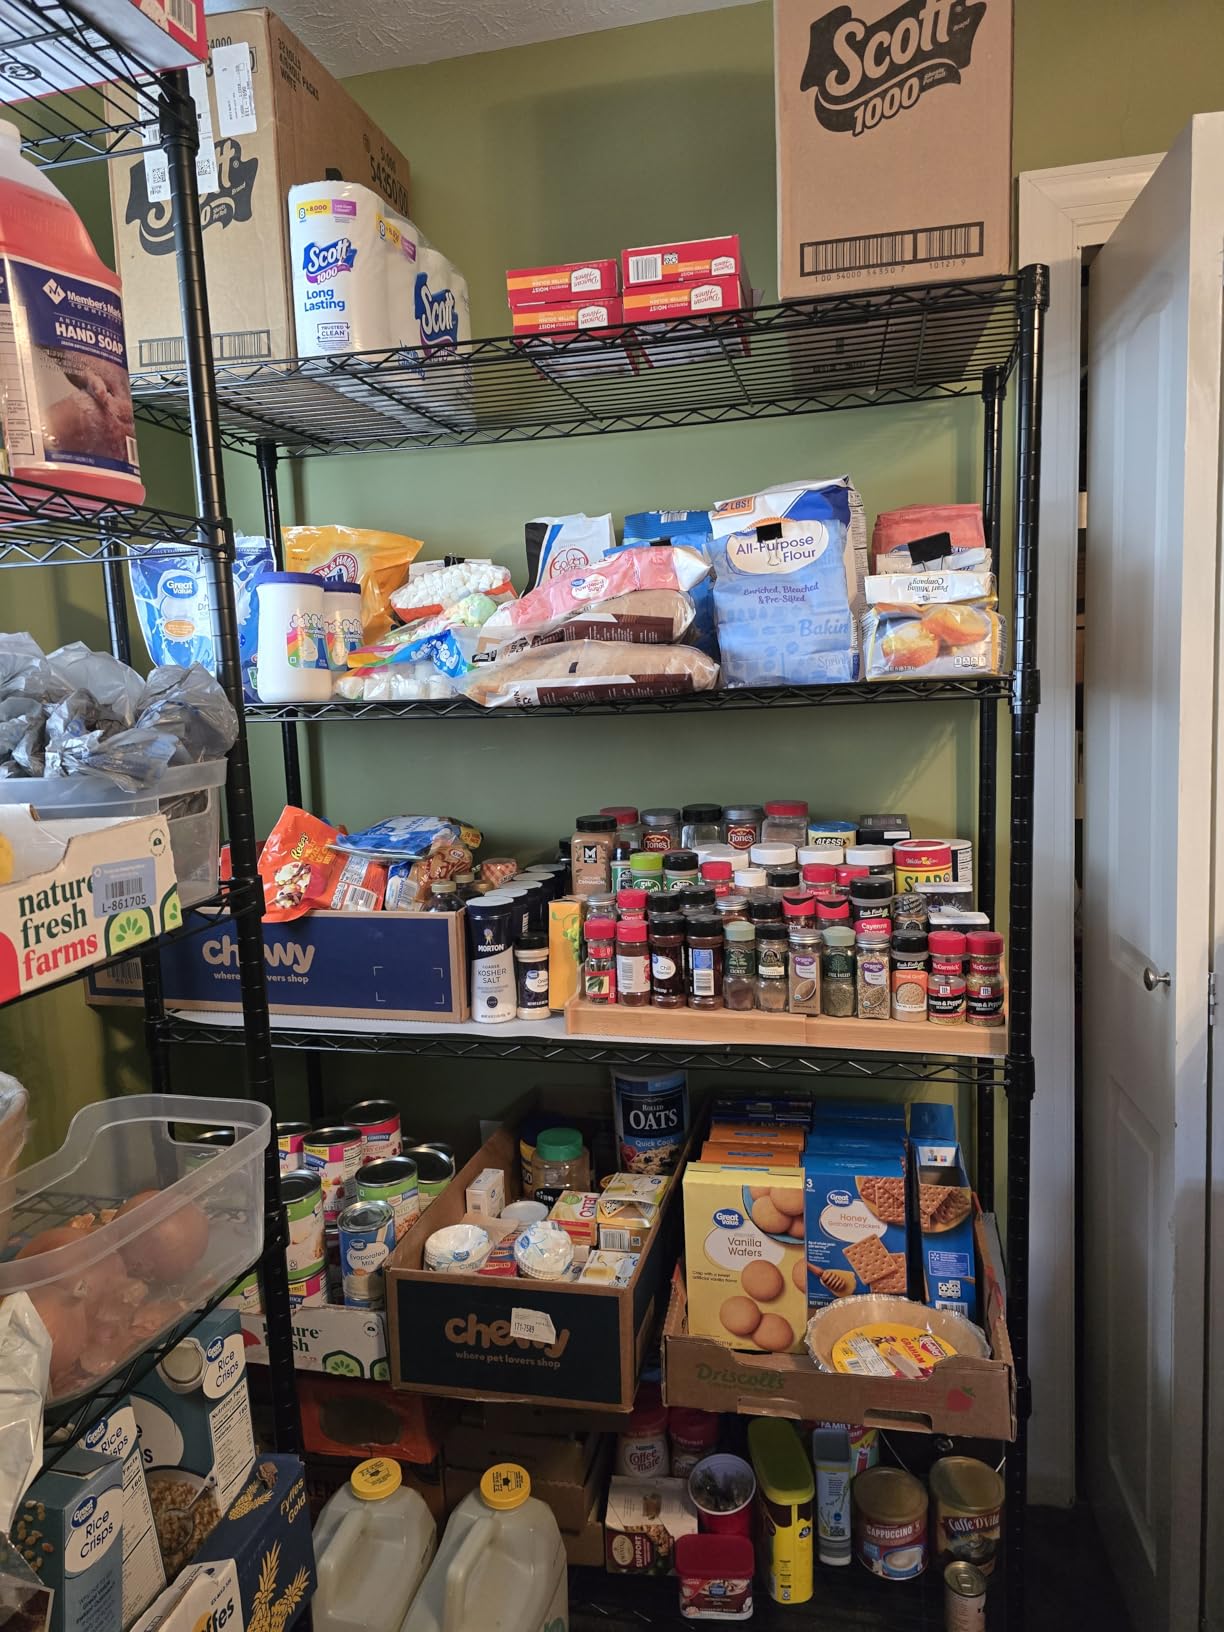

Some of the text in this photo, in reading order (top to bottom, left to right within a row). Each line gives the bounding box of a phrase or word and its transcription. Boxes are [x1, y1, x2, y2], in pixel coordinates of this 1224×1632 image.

[826, 0, 951, 97] Scott
[853, 76, 920, 138] 1000
[307, 238, 350, 273] Scott
[316, 266, 338, 285] 1000
[306, 288, 335, 301] Long
[532, 286, 549, 294] MOIST
[67, 290, 122, 320] Member's Mark
[304, 299, 346, 313] Lasting
[421, 284, 455, 335] Scott
[55, 322, 96, 345] HAND
[97, 335, 124, 356] SOAP
[730, 500, 751, 510] LBS!
[736, 535, 814, 556] All-Purpose
[783, 549, 817, 563] Flour
[166, 580, 193, 589] Great
[782, 581, 820, 594] Bleached
[645, 839, 668, 848] Tone's
[731, 833, 754, 842] Tone's
[101, 894, 147, 913] L-861705
[20, 902, 88, 950] fresh
[477, 943, 506, 952] MORTON
[22, 933, 98, 982] farms
[477, 968, 507, 977] KOSHER
[932, 963, 960, 971] McCormick
[287, 975, 310, 985] shop
[482, 976, 501, 984] SALT
[629, 1108, 679, 1130] OATS
[806, 1178, 813, 1188] 3
[829, 1193, 849, 1201] Great
[715, 1212, 739, 1222] Great
[840, 1213, 868, 1222] Honey
[853, 1222, 880, 1230] Crackers
[727, 1236, 762, 1248] Vanilla
[349, 1249, 386, 1261] Evaporated
[727, 1246, 763, 1258] Wafers
[900, 1337, 927, 1364] GRAHAM
[217, 1350, 235, 1372] Rice
[455, 1350, 561, 1371] where pet lovers shop
[215, 1360, 239, 1388] Crisps
[86, 1422, 107, 1445] Great
[101, 1426, 123, 1453] Rice
[629, 1450, 658, 1466] Coffee
[131, 1475, 142, 1491] 160
[74, 1501, 95, 1520] Great
[287, 1491, 306, 1524] Gold
[85, 1510, 110, 1539] Rice
[866, 1525, 913, 1540] CAPPUCCINO
[79, 1522, 114, 1559] Crisps
[635, 1535, 644, 1568] SUPPORT
